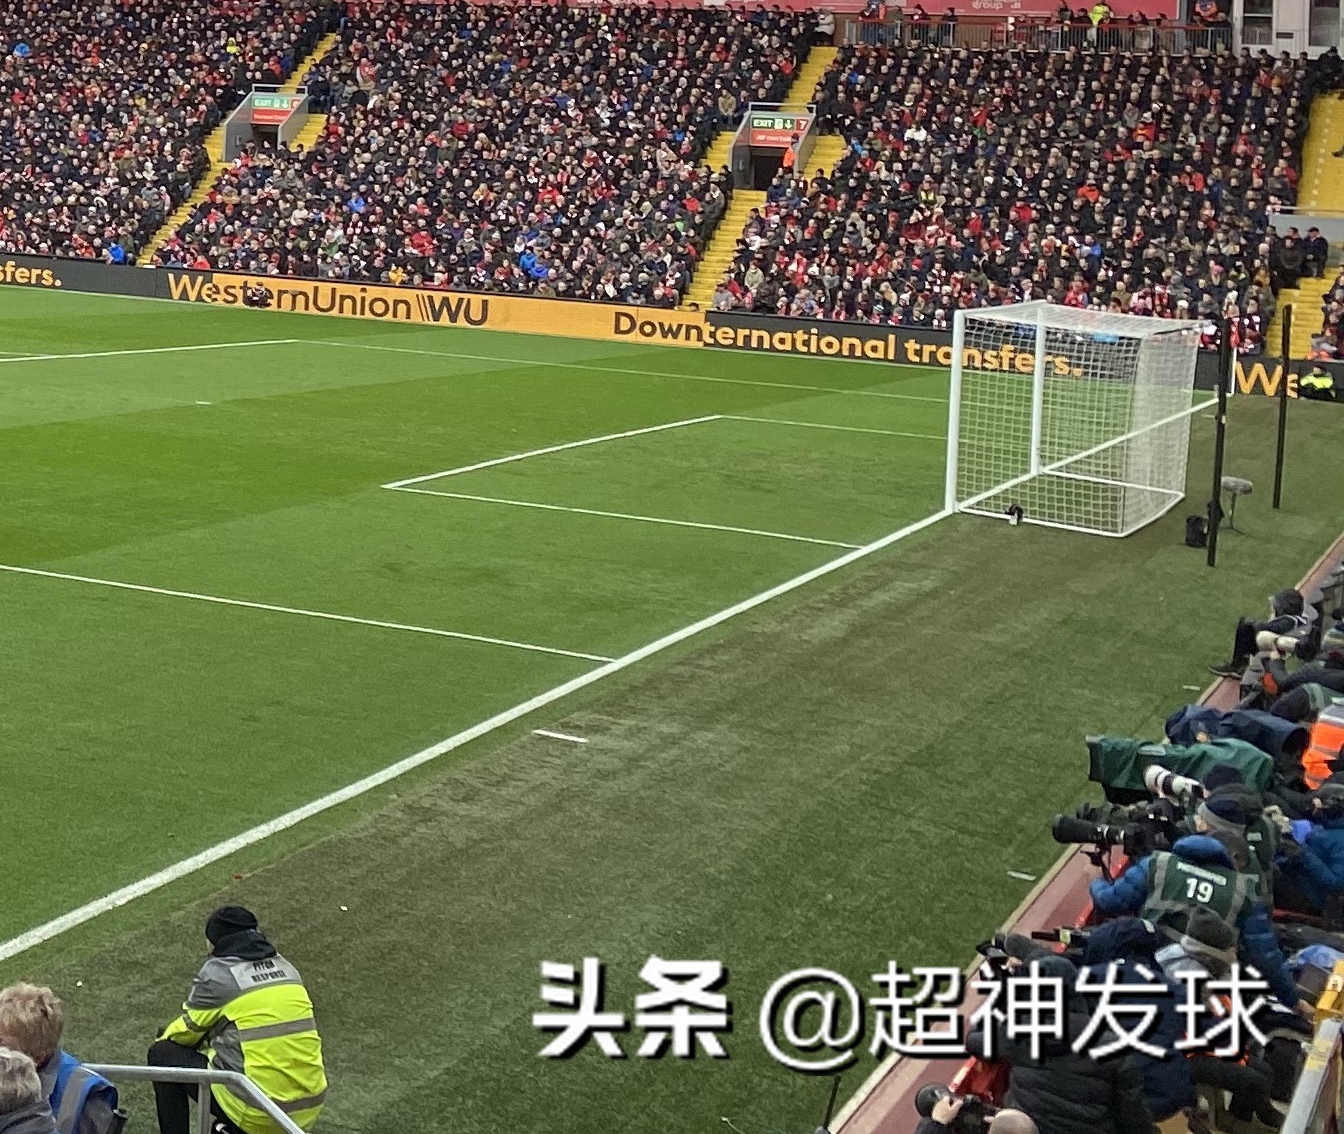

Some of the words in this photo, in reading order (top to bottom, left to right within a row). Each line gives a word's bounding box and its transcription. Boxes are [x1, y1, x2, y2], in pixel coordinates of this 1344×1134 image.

[753, 119, 773, 127] EXIT
[799, 120, 807, 128] 7
[1186, 877, 1214, 903] 19
[252, 959, 275, 972] PITCH
